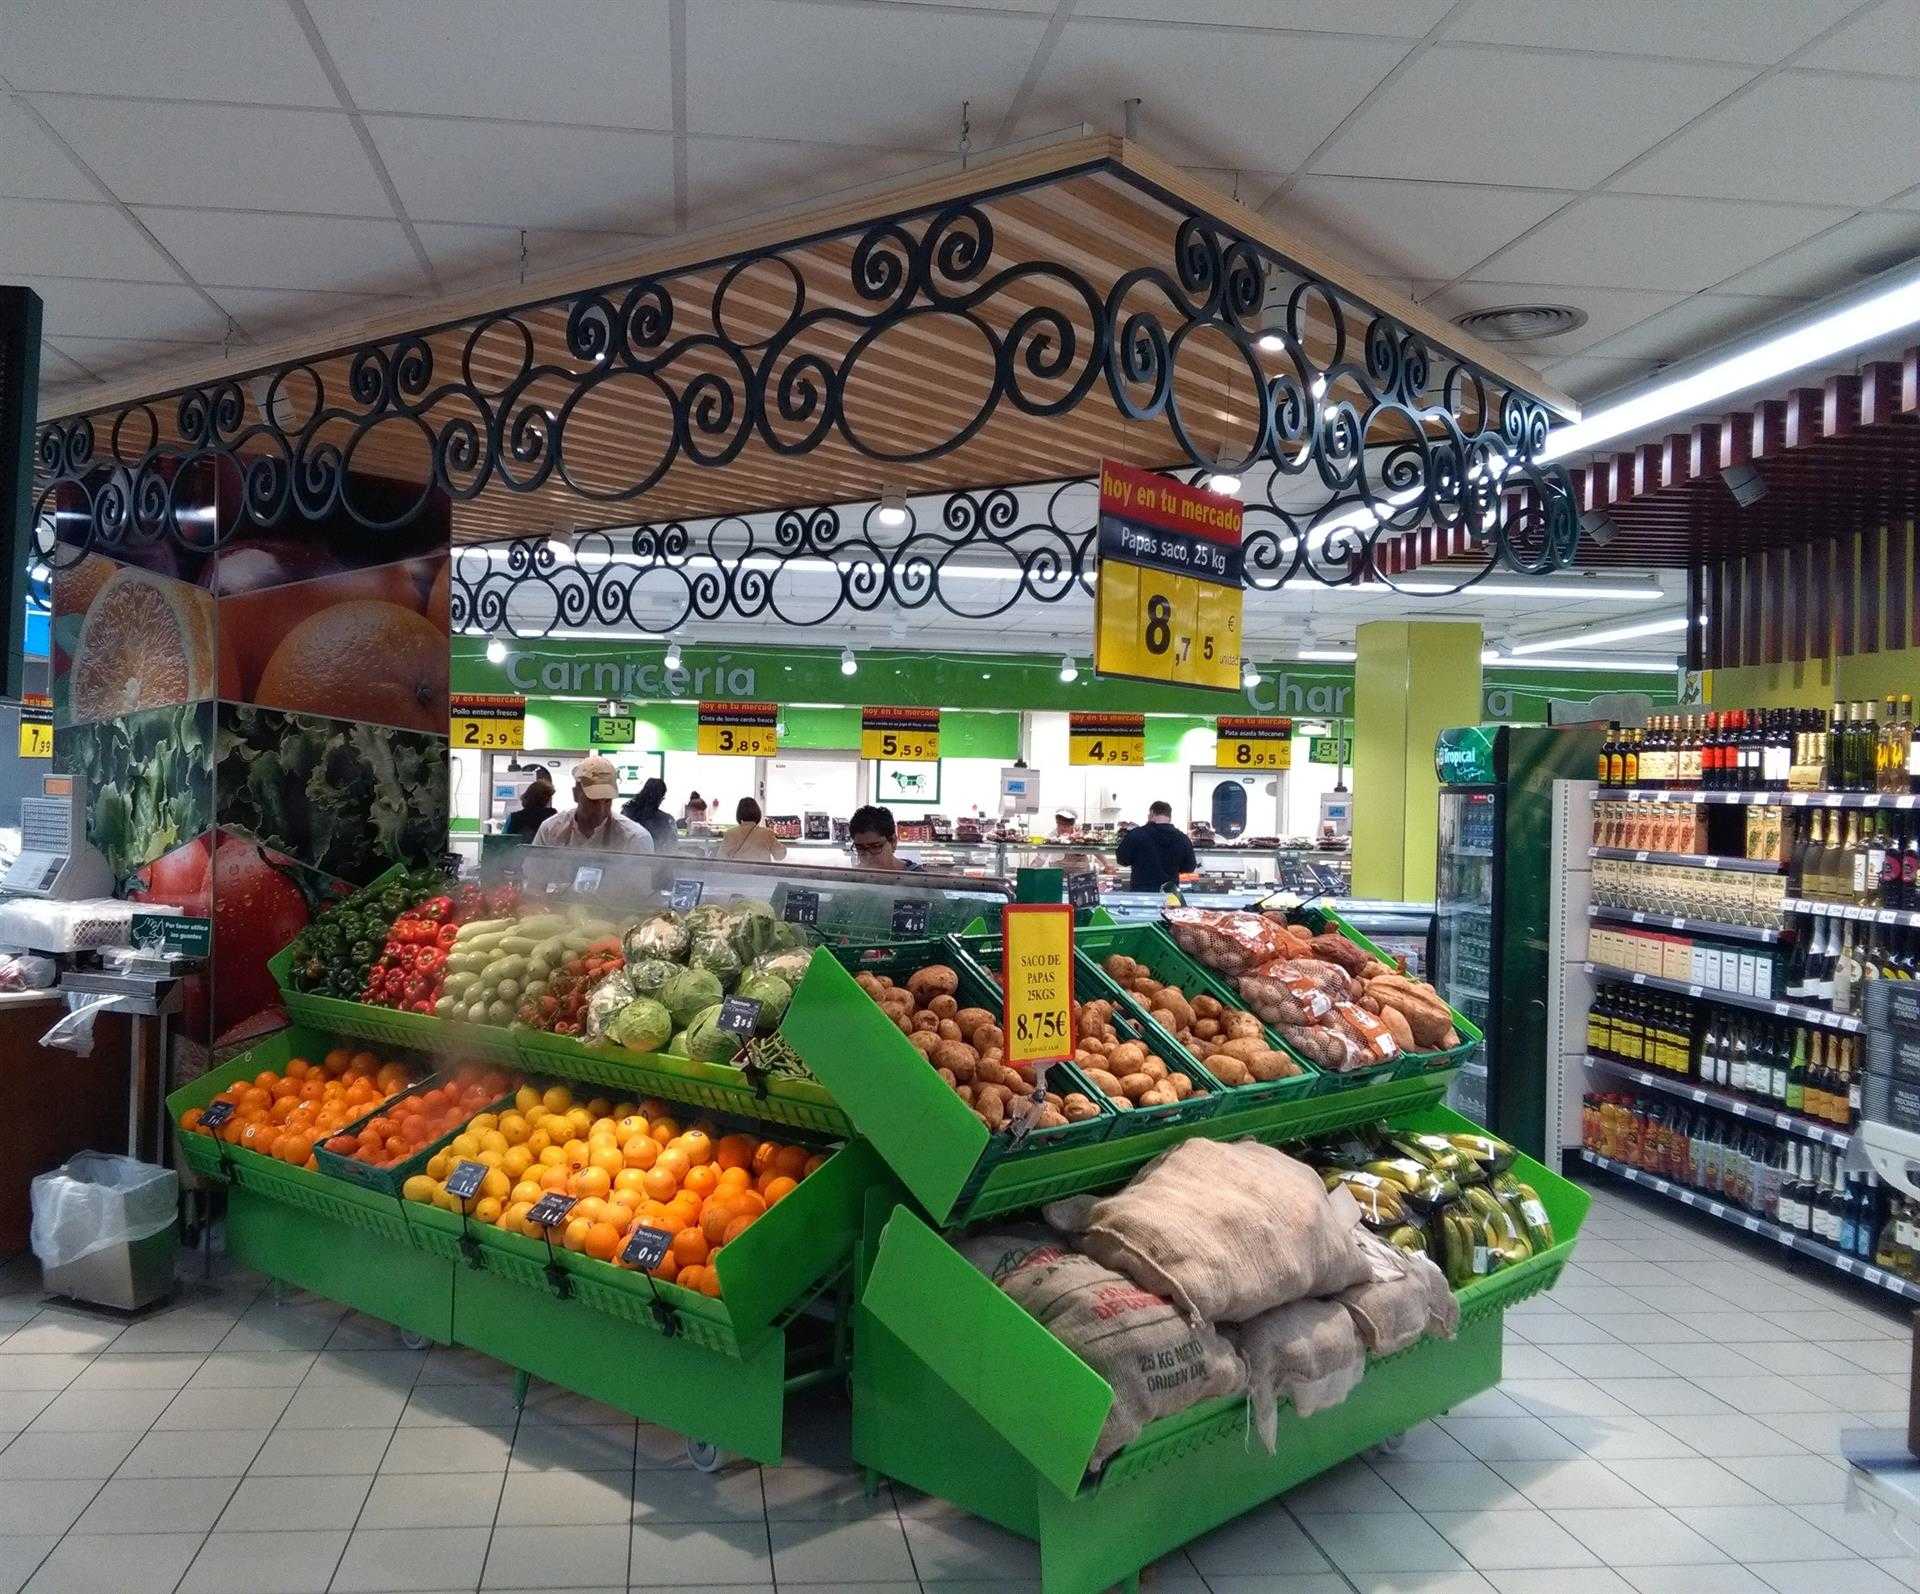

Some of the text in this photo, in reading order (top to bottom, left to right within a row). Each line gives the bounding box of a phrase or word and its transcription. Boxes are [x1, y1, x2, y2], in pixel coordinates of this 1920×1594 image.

[1103, 471, 1240, 532] hoy en tu mercado
[1121, 527, 1226, 575] Papas saco, 25 kg
[506, 652, 755, 696] Carnicería
[604, 720, 631, 736] 34
[1444, 747, 1475, 767] Tropical
[1021, 954, 1061, 968] SACO DE
[1027, 971, 1055, 984] PAPAS
[1027, 988, 1056, 1001] 25KGS
[1017, 1010, 1067, 1046] 8,75€
[1157, 1350, 1174, 1369] KG
